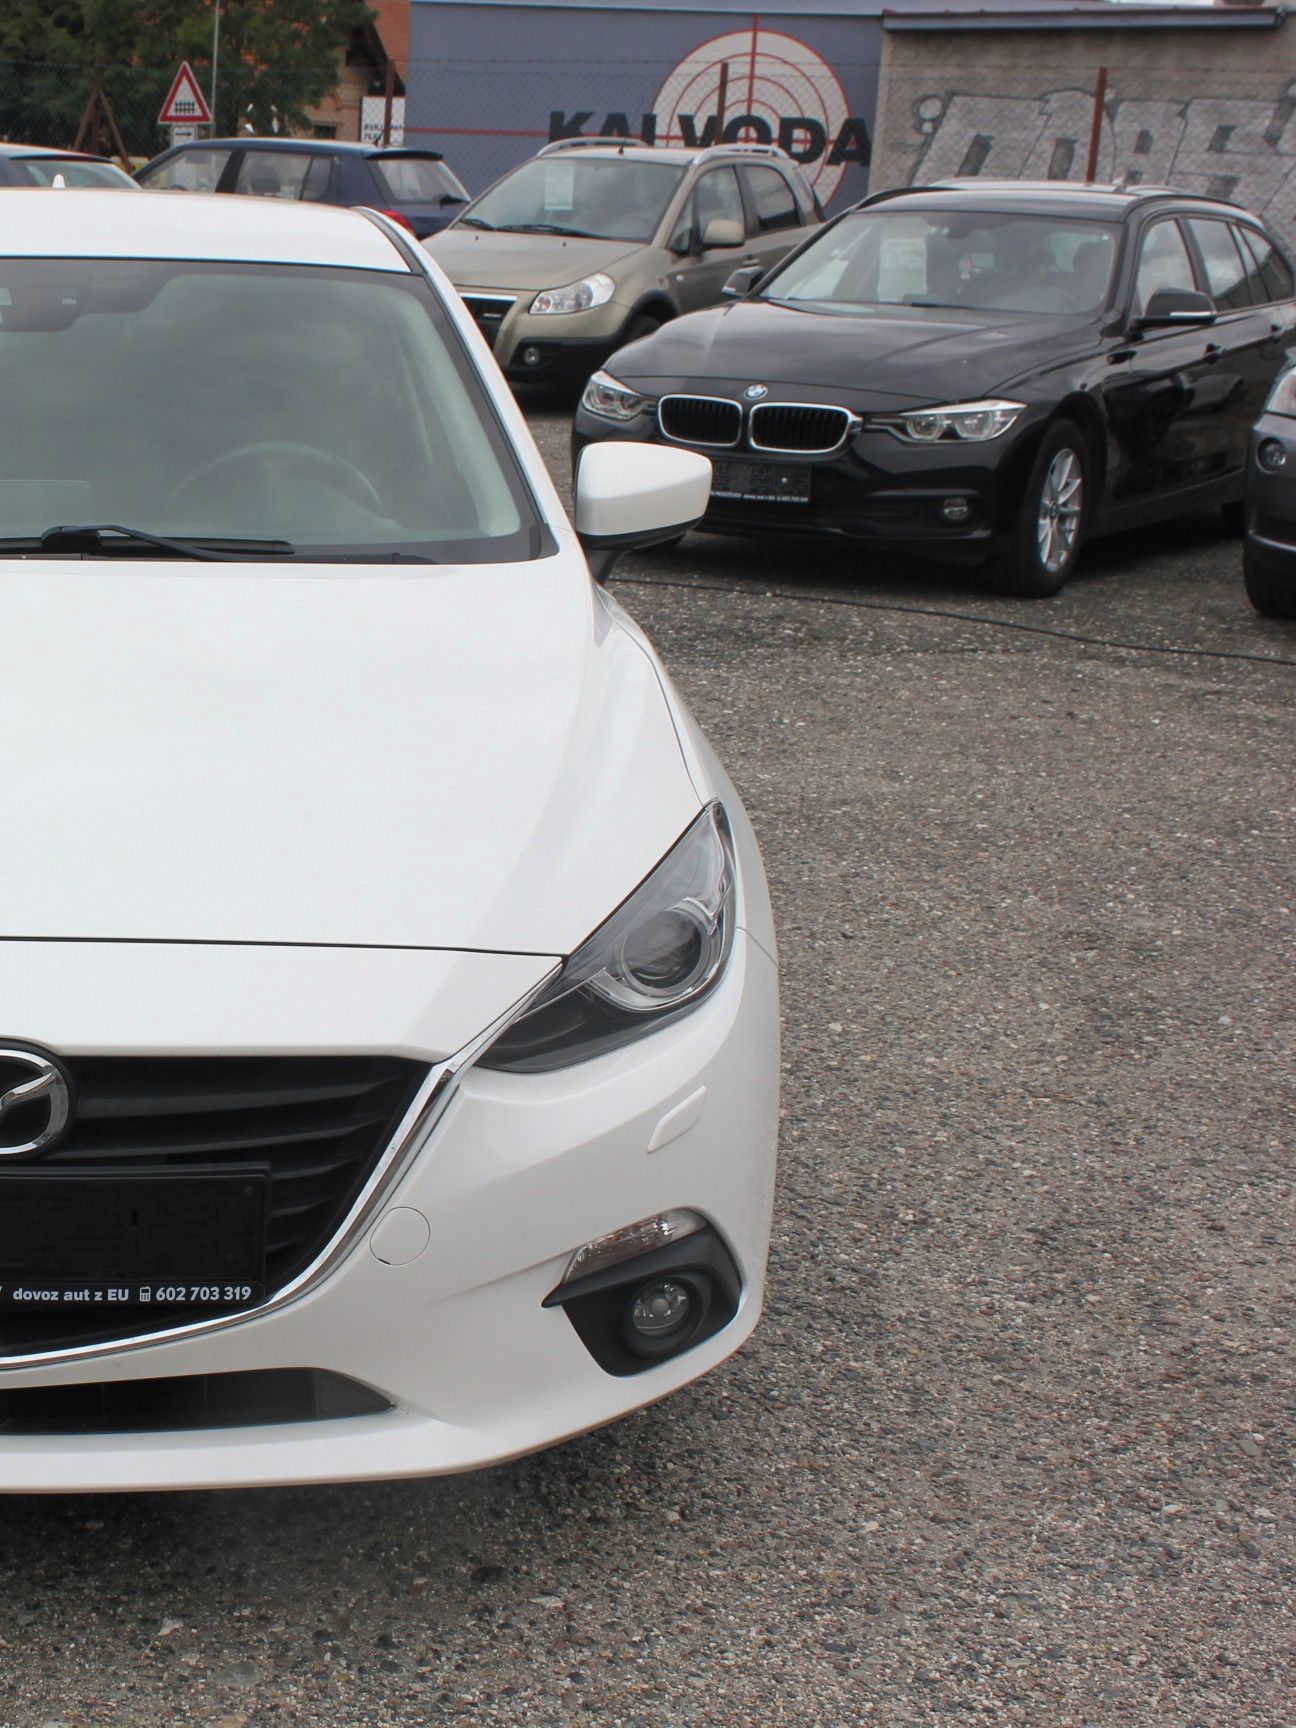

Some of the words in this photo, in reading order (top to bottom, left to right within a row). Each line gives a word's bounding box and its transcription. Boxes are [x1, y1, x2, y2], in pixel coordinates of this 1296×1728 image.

[549, 111, 872, 167] KALVODA
[13, 1288, 59, 1301] dovoz
[63, 1289, 90, 1301] aut
[94, 1291, 103, 1301] z
[107, 1289, 129, 1301] EU
[156, 1287, 186, 1301] 602
[190, 1287, 219, 1301] 703
[224, 1286, 252, 1300] 319
